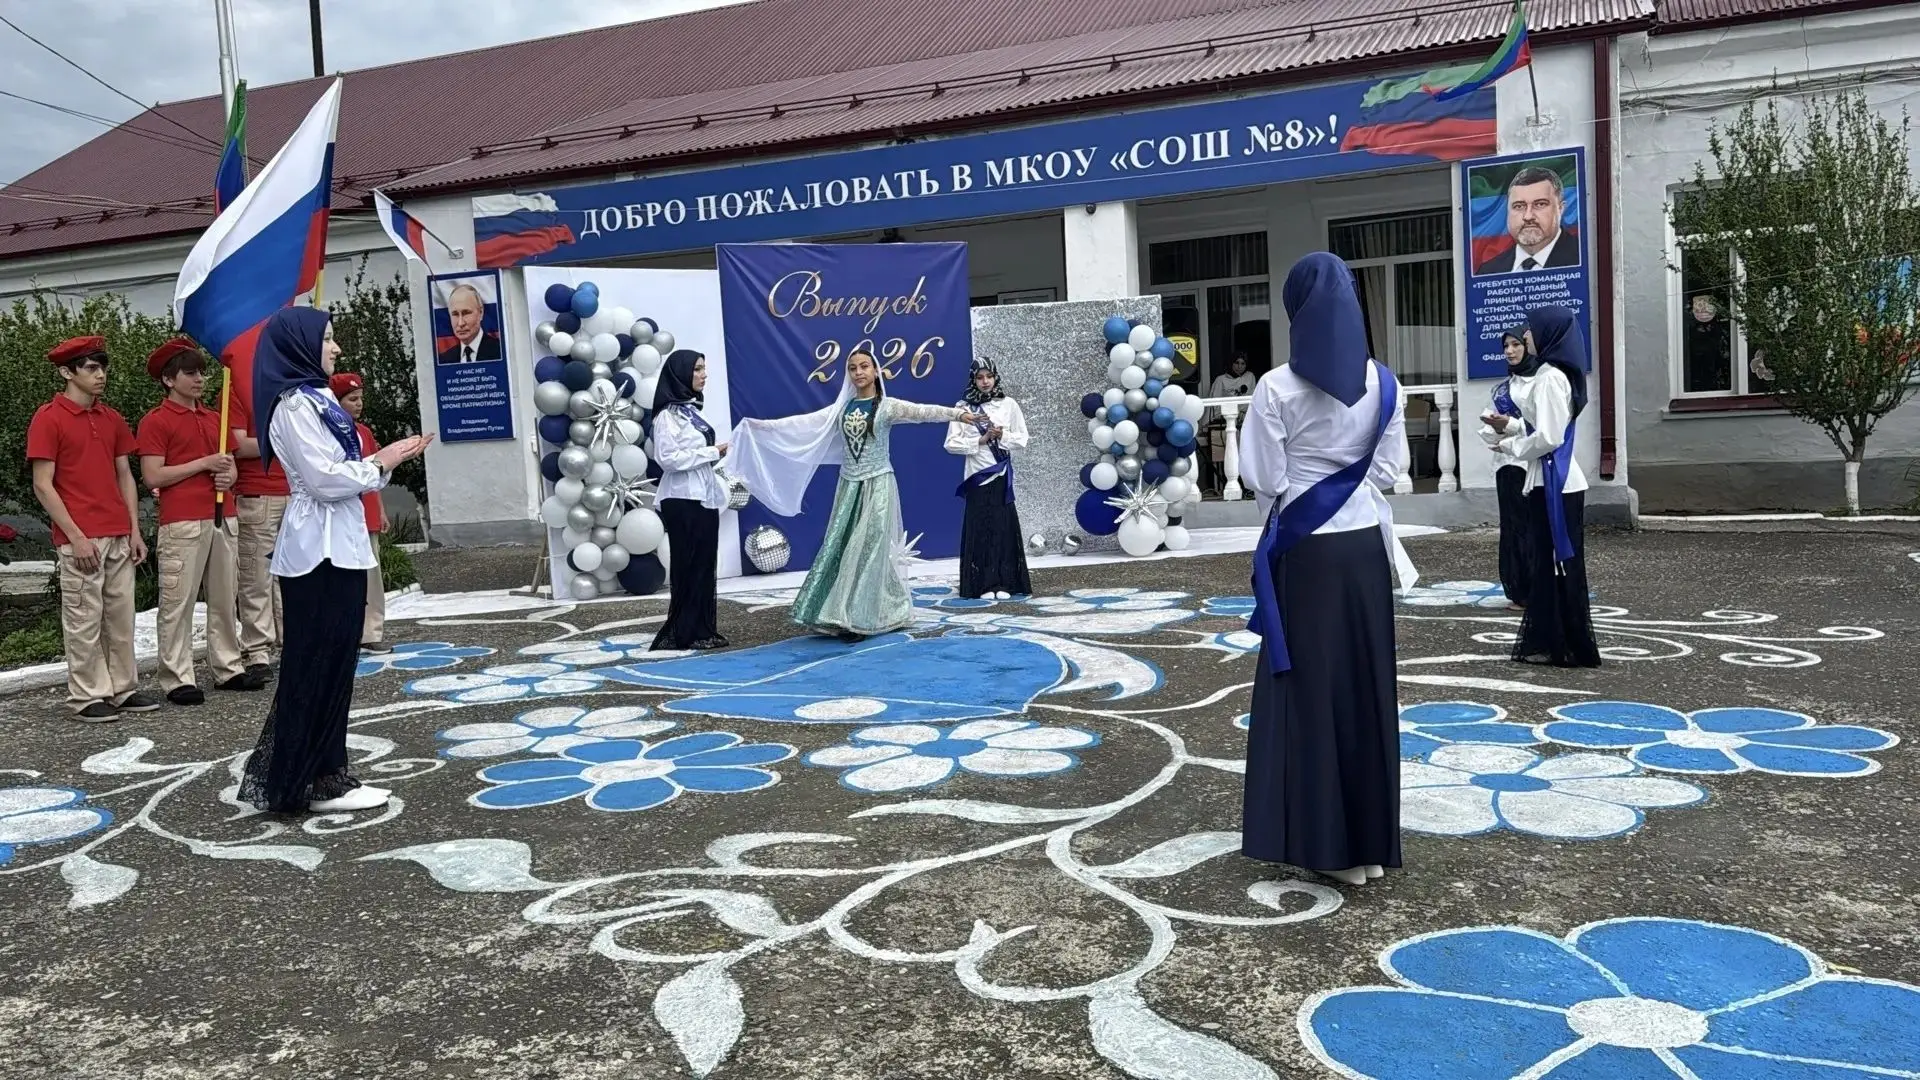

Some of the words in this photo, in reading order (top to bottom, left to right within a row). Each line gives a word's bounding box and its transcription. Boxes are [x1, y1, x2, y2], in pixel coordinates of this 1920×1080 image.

[580, 199, 686, 240] ДОБРО
[696, 168, 940, 223] ПОЖАЛОВАТЬ
[951, 164, 973, 192] В
[984, 146, 1098, 188] МКОУ
[1109, 128, 1231, 172] «СОШ
[1243, 114, 1338, 156] №8»!
[1473, 278, 1523, 289] «ТРЕБУЕТСЯ
[1525, 272, 1581, 284] КОМАНДНАЯ
[1487, 287, 1523, 297] РАБОТА,
[1524, 281, 1567, 293] ГЛАВНЫЙ
[768, 270, 928, 334] Выпуск
[1484, 295, 1527, 306] ПРИНЦИП
[1529, 290, 1571, 301] КОТОРОЙ
[1473, 304, 1523, 315] ЧЕСТНОСТЬ,
[1482, 323, 1501, 332] ДЛЯ
[475, 383, 497, 391] ДРУГОЙ
